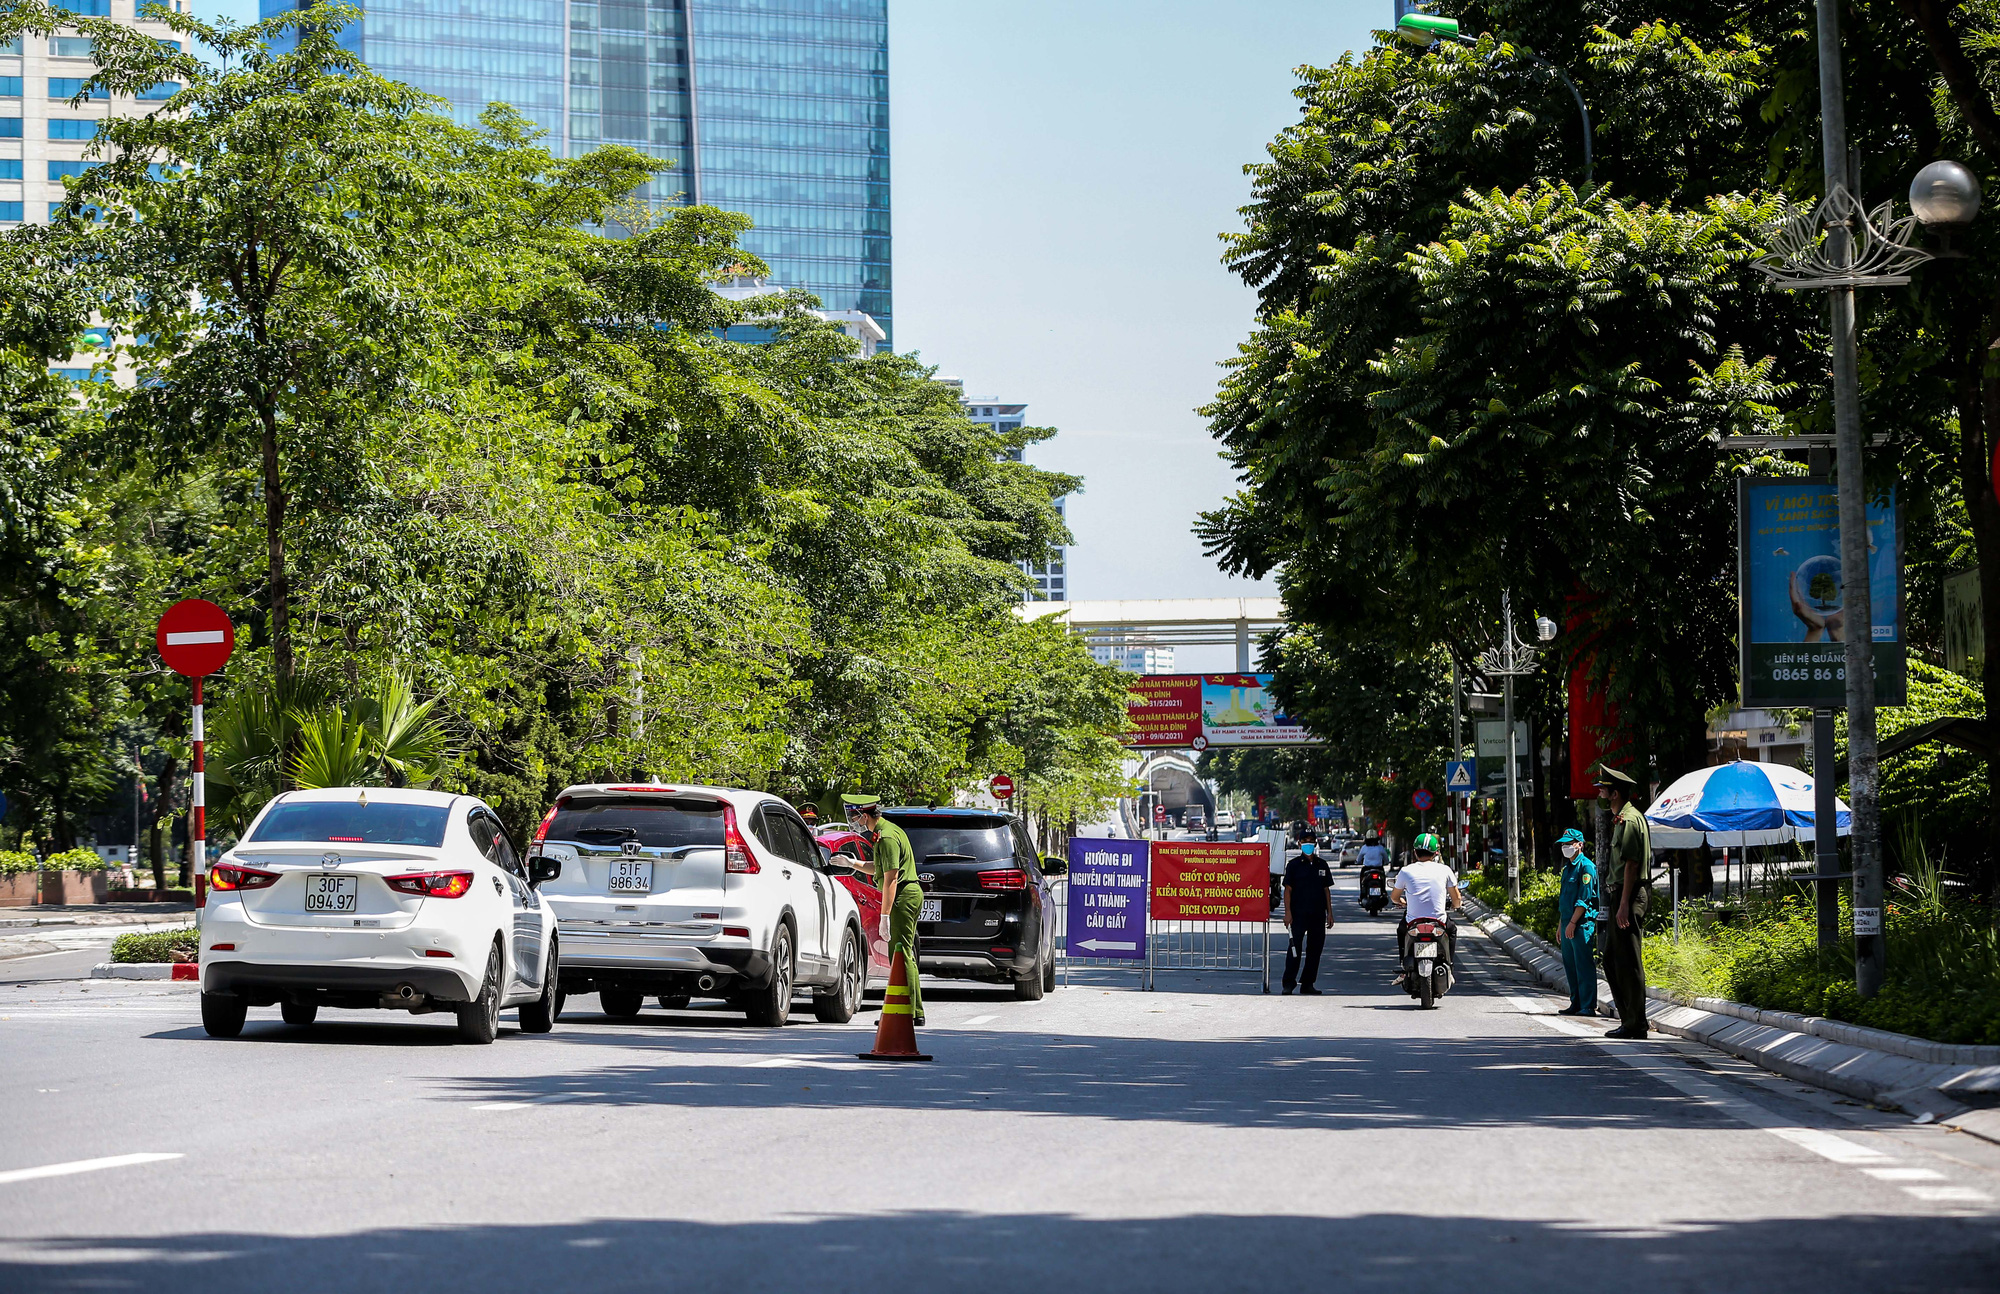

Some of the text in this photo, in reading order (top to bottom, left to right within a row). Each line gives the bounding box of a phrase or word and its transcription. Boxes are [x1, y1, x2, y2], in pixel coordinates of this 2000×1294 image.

[1765, 495, 1779, 511] VÌ
[1783, 493, 1813, 509] MÔI
[1776, 510, 1809, 522] XANH
[1774, 653, 1794, 663] LIÊN
[1797, 653, 1809, 665] HỆ
[1772, 669, 1809, 681] 0865
[1814, 668, 1832, 680] 86
[1145, 680, 1160, 688] NĂM
[1161, 679, 1185, 688] THÀNH
[1185, 679, 1199, 689] LẬP
[1154, 690, 1171, 698] ĐÌNH
[1149, 699, 1183, 708] 31/5/2021)
[1145, 713, 1160, 721] NĂM
[1162, 712, 1185, 721] THÀNH
[1186, 712, 1199, 722] LẬP
[1140, 724, 1159, 732] QUẬN
[1170, 722, 1187, 731] ĐÌNH
[1150, 732, 1183, 741] 09/6/2021)
[1672, 793, 1695, 804] NCB
[1085, 849, 1132, 867] HƯỚNG ĐI
[1170, 847, 1179, 855] CHỈ
[1209, 848, 1226, 856] CHỐNG
[620, 863, 642, 876] 51F
[610, 876, 649, 889] 986.34
[1071, 868, 1145, 888] NGUYỄN CHÍ THANH-
[1179, 868, 1241, 885] CHỐT CƠ ĐỘNG
[319, 878, 345, 893] 30F
[1156, 882, 1264, 899] KIỂM SOÁT, PHÒNG CHỐNG
[308, 894, 354, 910] 094.97
[1084, 892, 1130, 908] LA THÀNH-
[1179, 904, 1240, 917] DỊCH COVID-19
[1086, 911, 1127, 929] CẦU GIẤY
